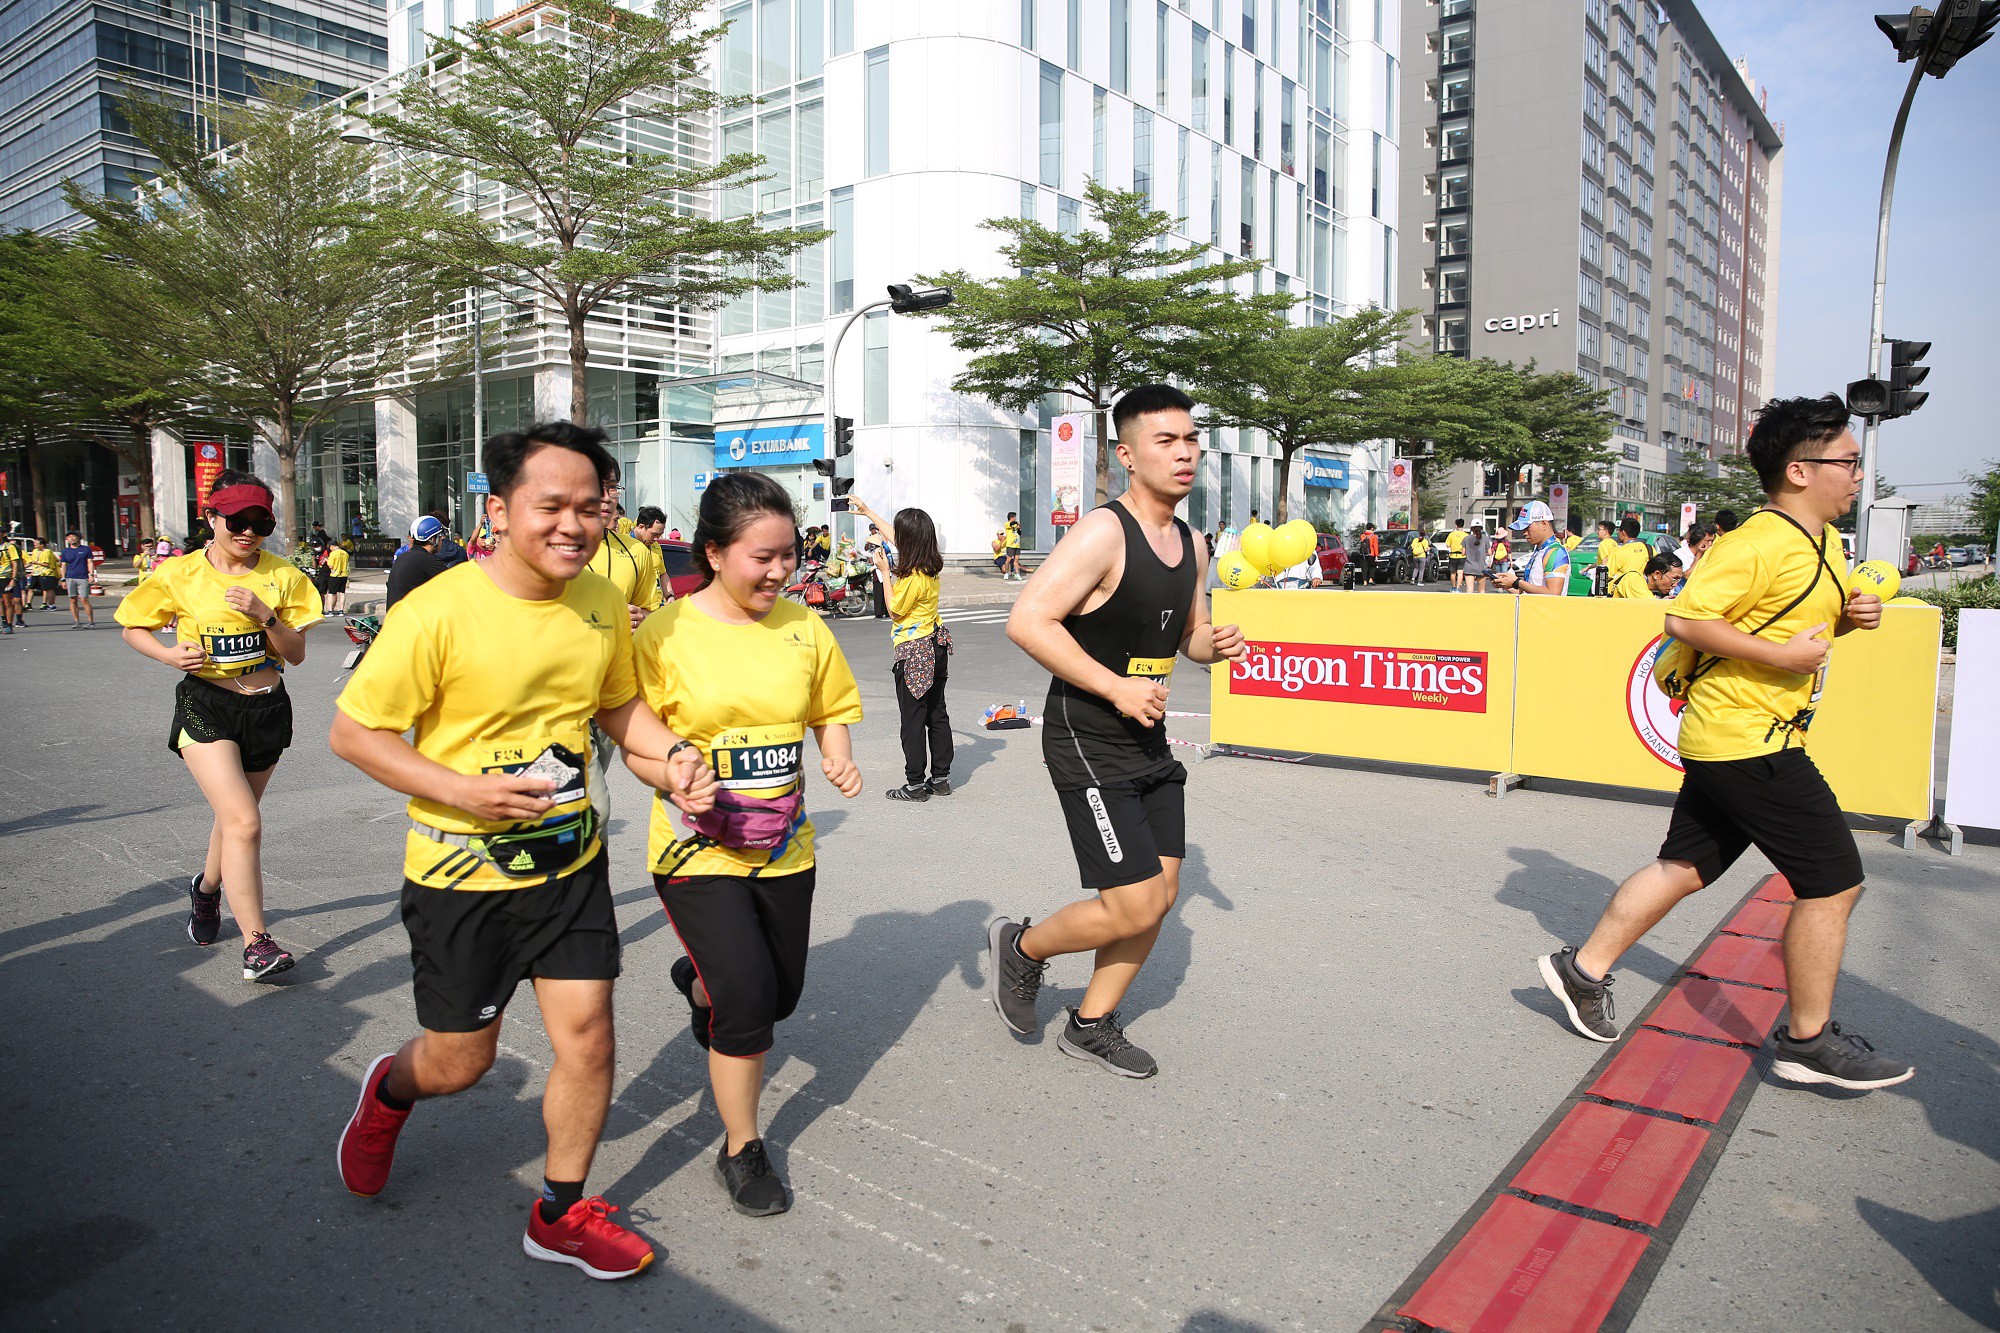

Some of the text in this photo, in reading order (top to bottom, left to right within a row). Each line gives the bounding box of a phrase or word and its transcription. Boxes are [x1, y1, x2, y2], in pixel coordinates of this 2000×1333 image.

[1485, 308, 1559, 334] capri
[752, 438, 810, 454] EXIMBANK
[217, 634, 260, 651] 11101
[1252, 645, 1266, 653] The
[1232, 645, 1483, 695] Saigon Times
[1412, 692, 1449, 706] Weekly
[739, 746, 797, 771] 11084
[1090, 794, 1119, 854] NIKE PRO
